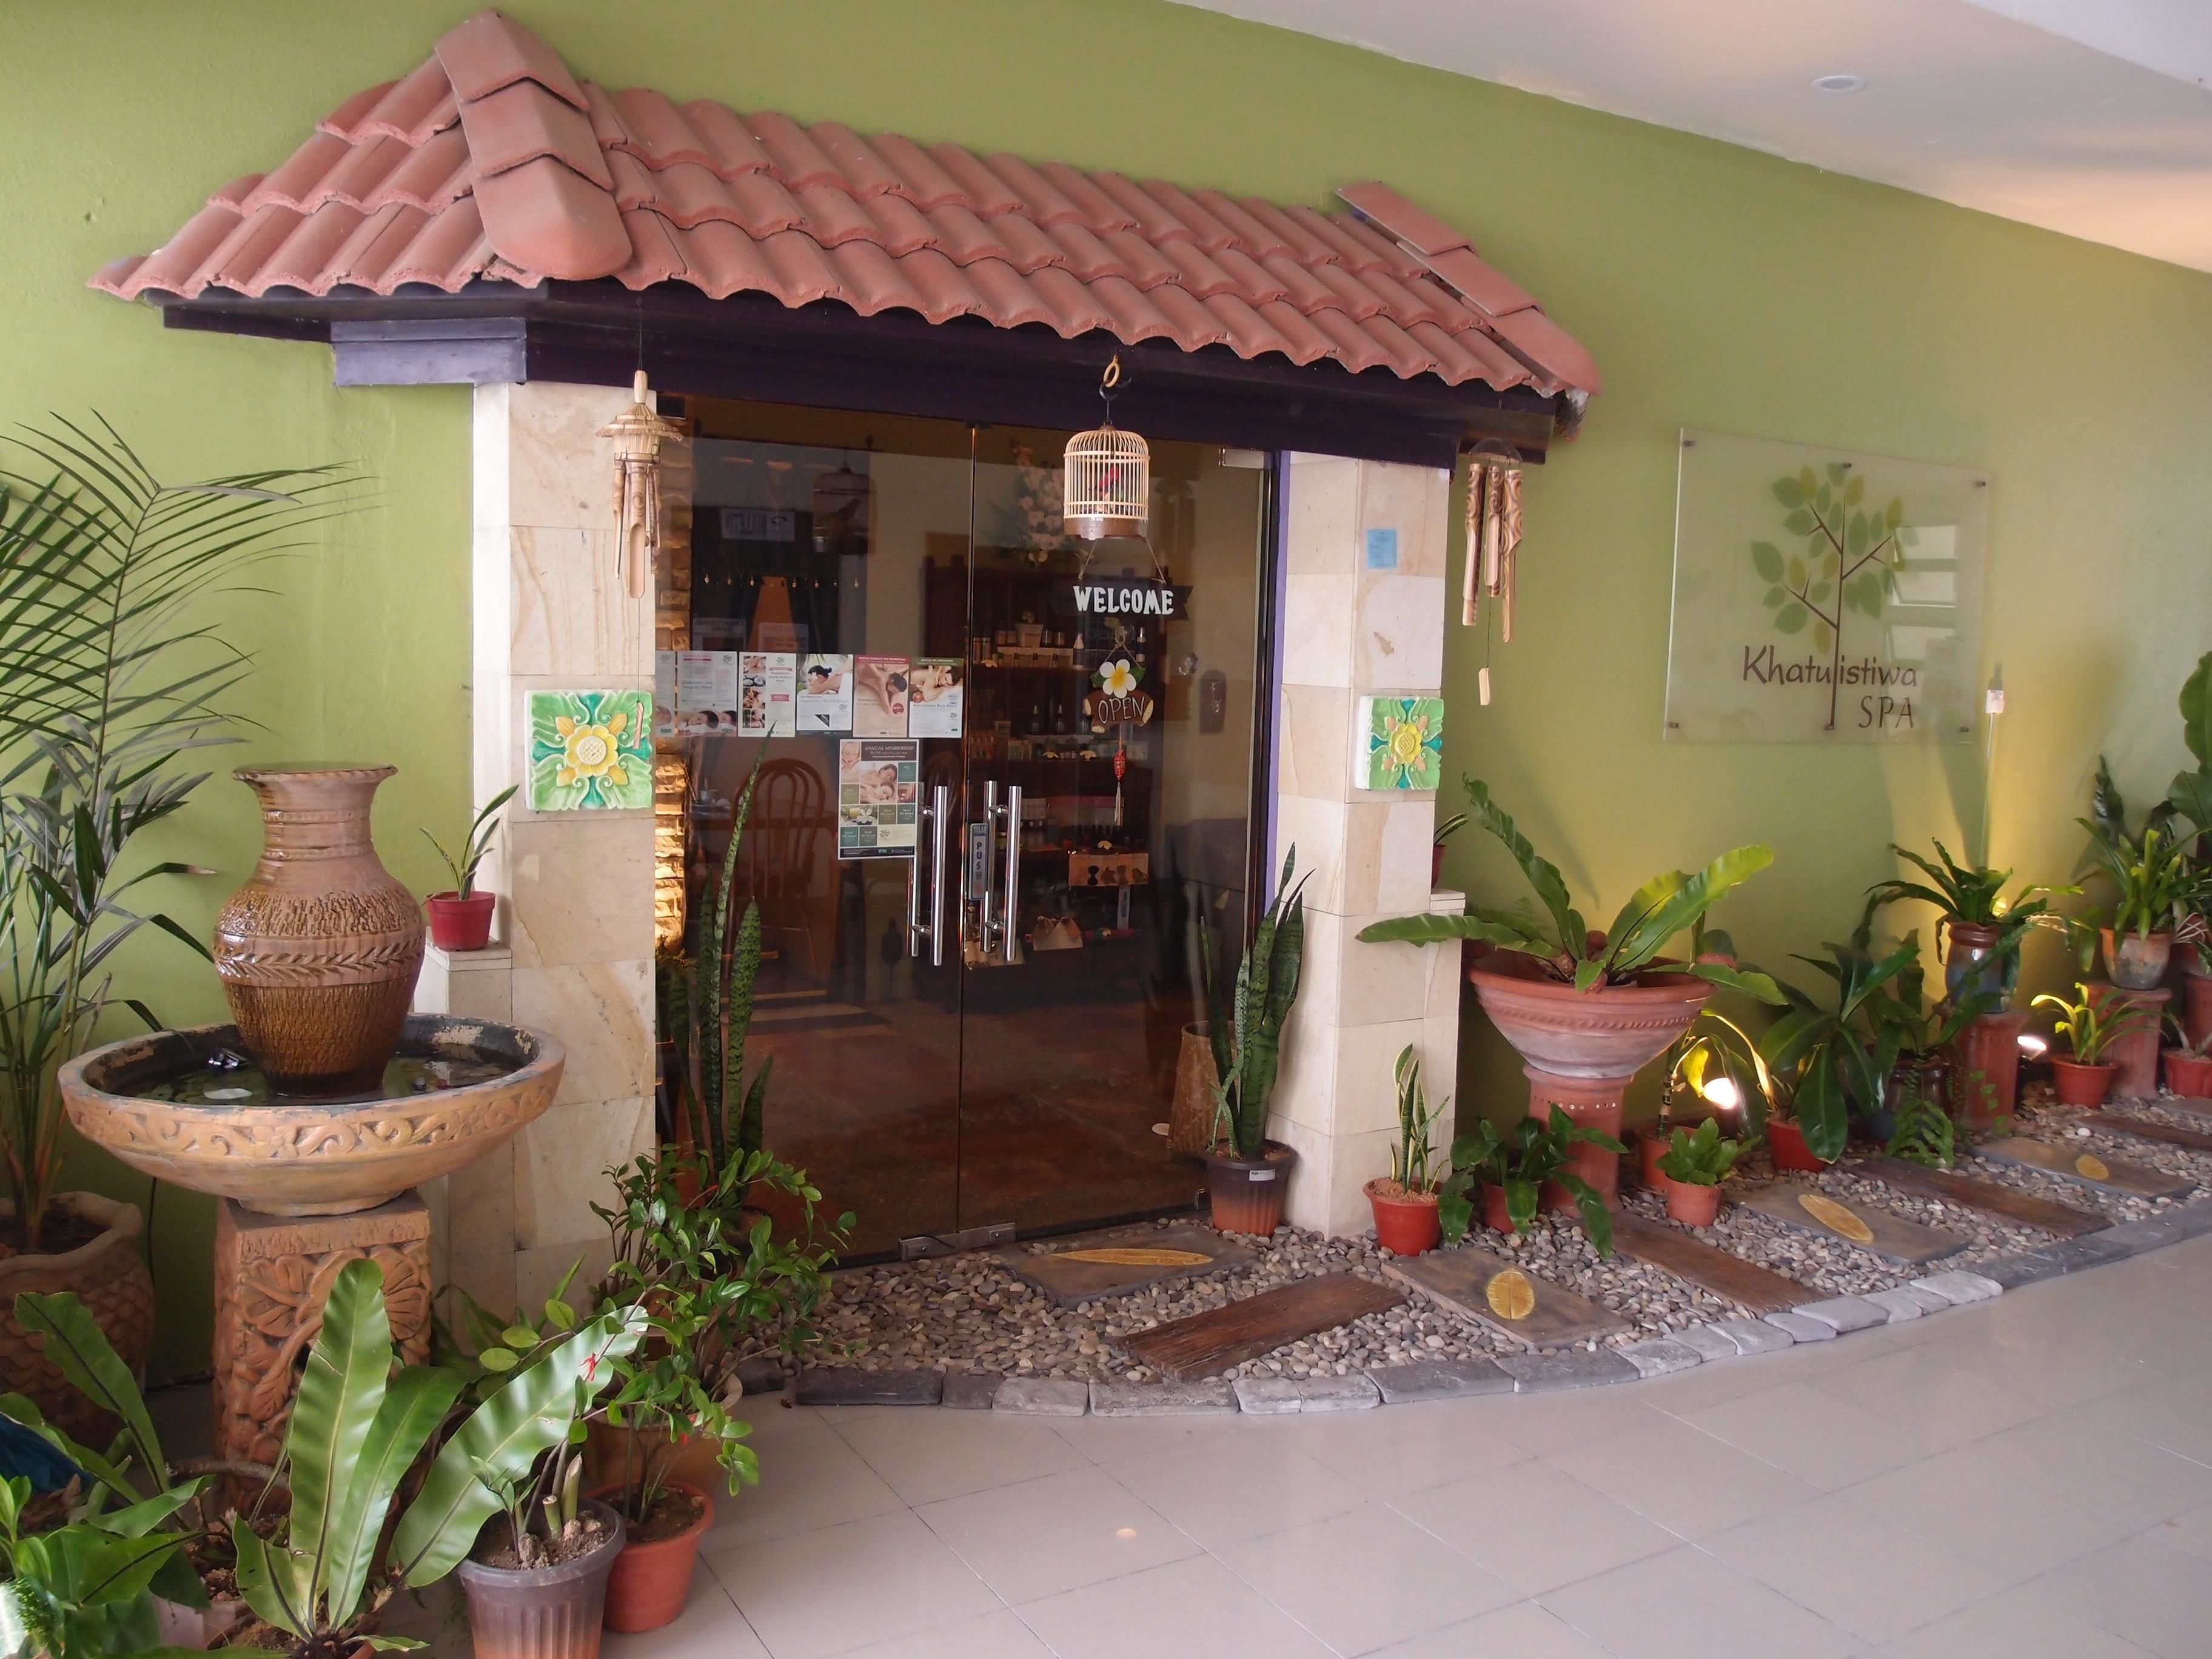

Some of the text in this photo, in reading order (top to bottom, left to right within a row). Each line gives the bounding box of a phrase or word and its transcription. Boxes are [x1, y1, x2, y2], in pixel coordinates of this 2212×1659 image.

[1073, 585, 1174, 615] WELCOME
[1743, 645, 1918, 686] Khatulistiwa
[1098, 695, 1145, 725] OPEN
[1858, 695, 1914, 728] SPA
